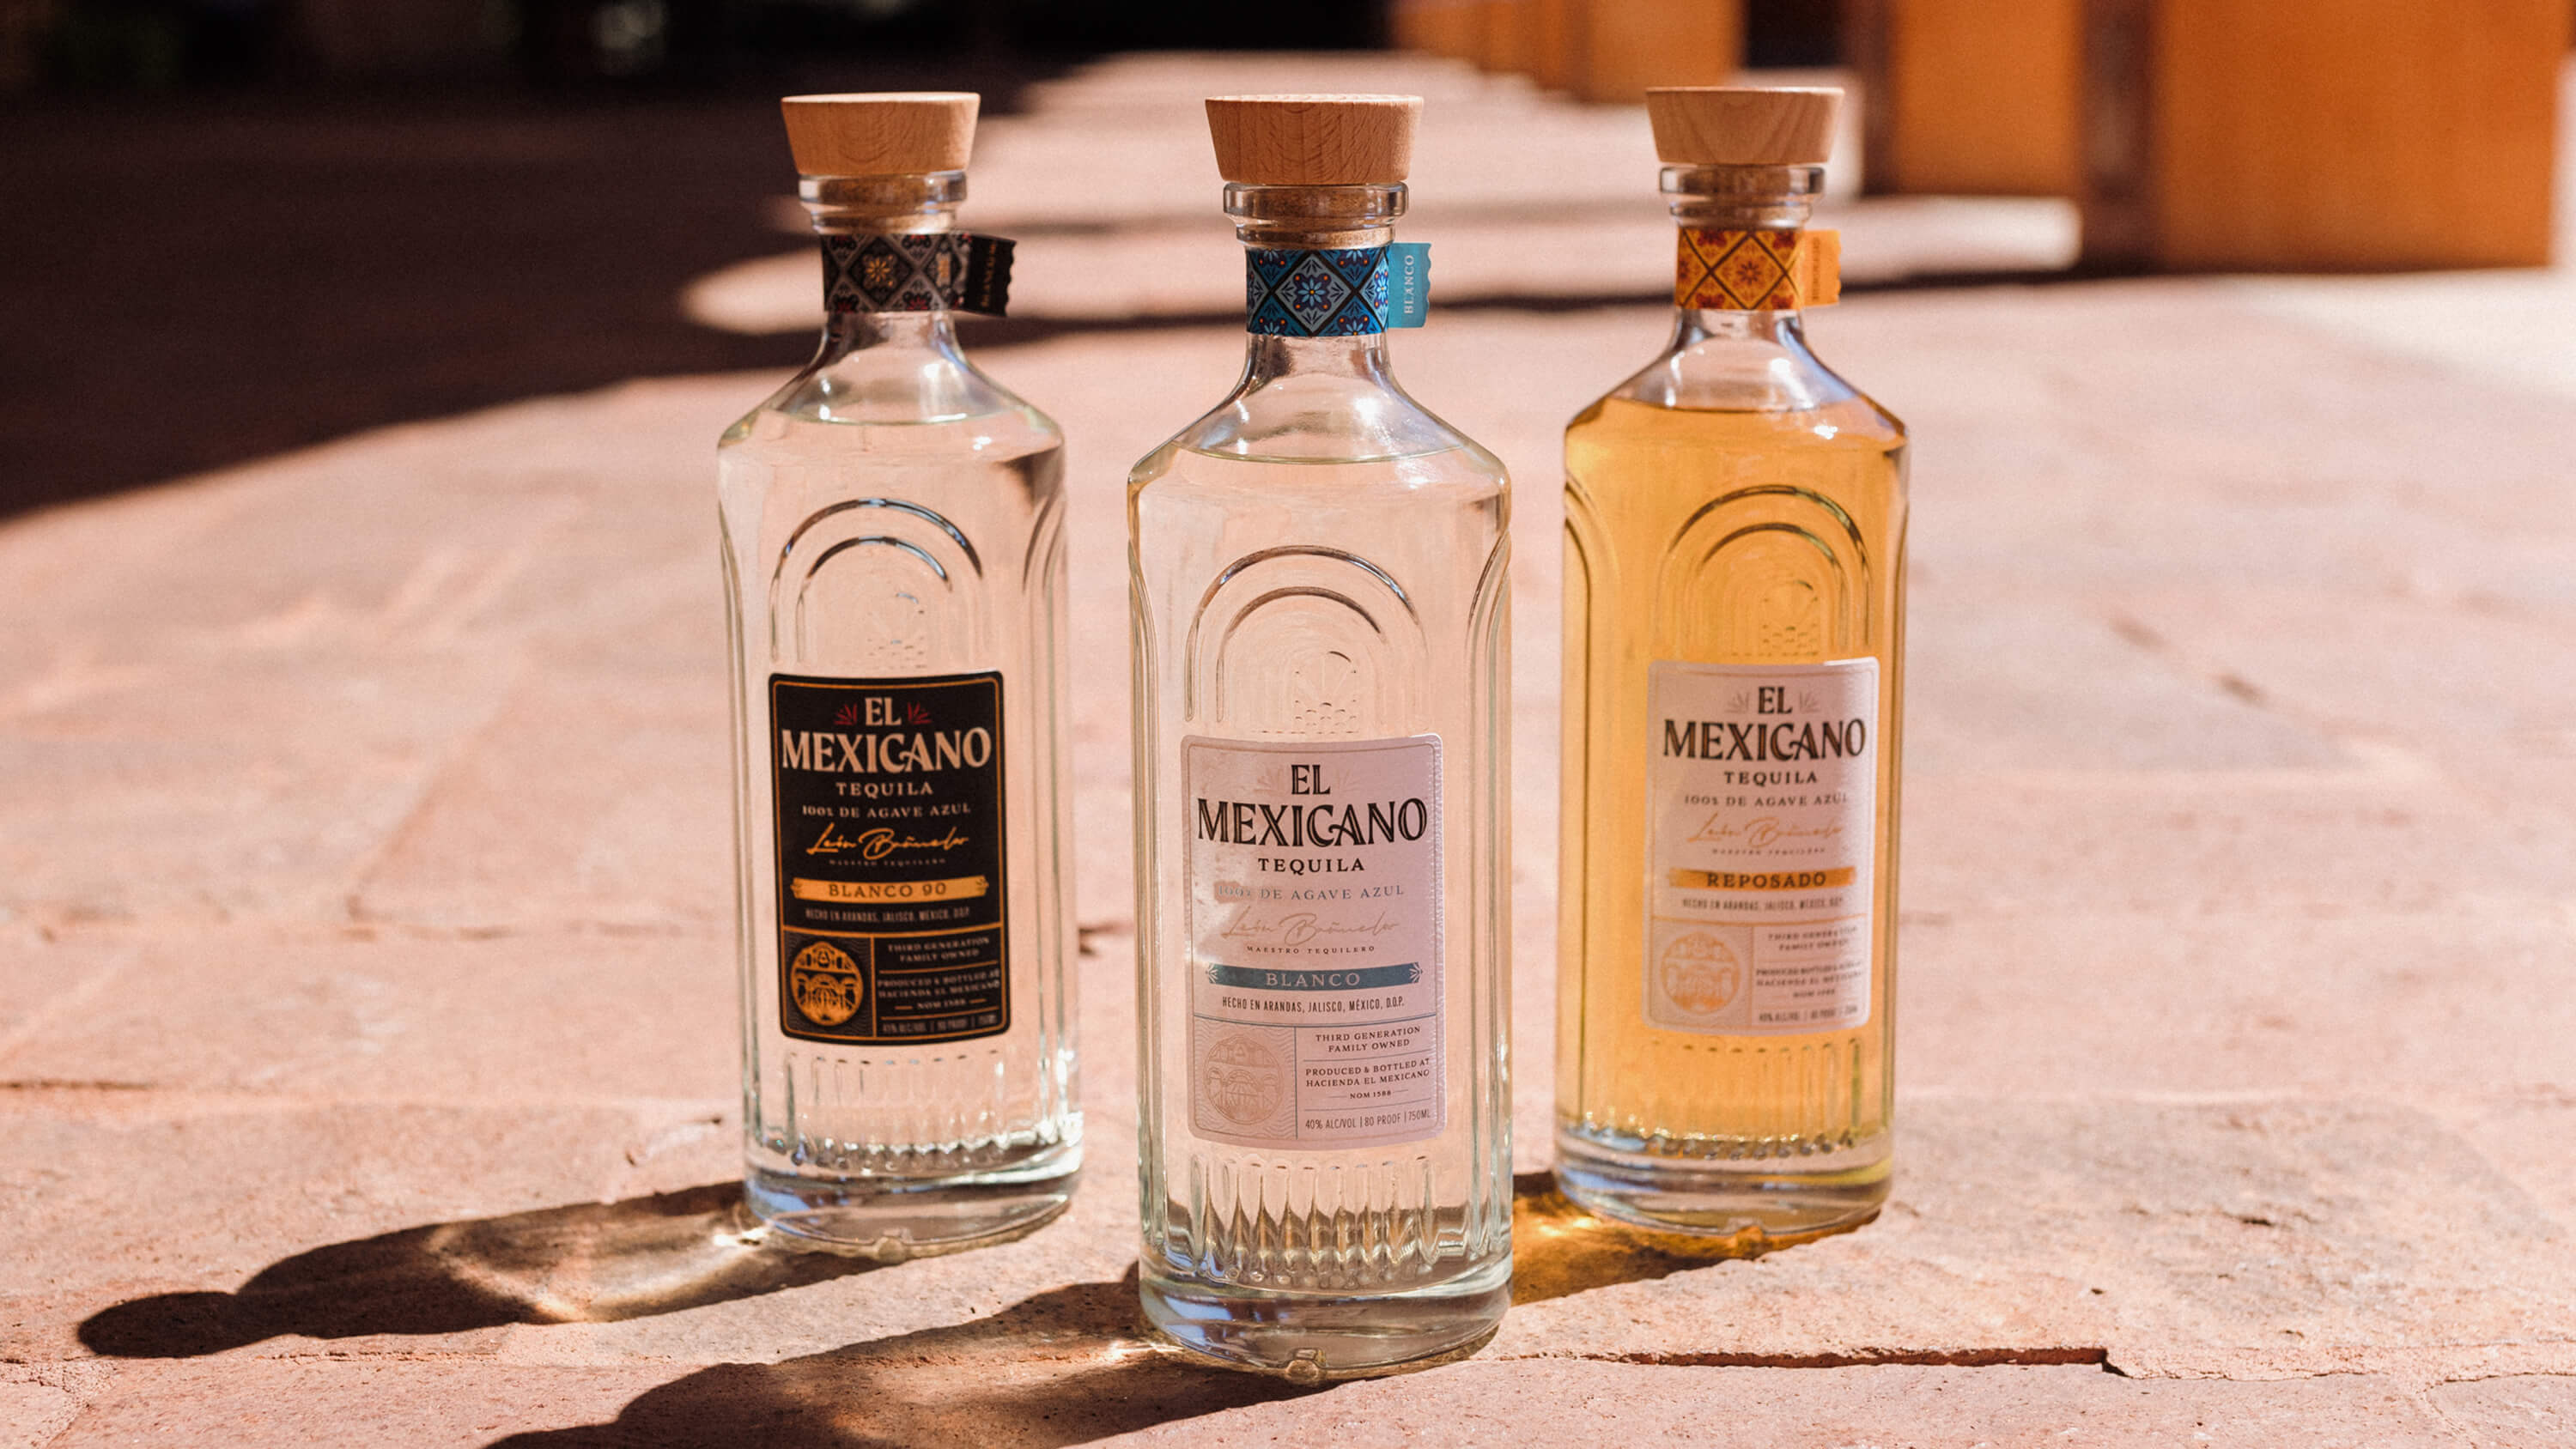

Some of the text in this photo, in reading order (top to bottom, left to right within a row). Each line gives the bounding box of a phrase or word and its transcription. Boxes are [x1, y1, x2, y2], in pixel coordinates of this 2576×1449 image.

[1404, 255, 1415, 314] BLANCO
[1758, 687, 1793, 714] EL
[865, 697, 902, 726] EL
[1663, 718, 1866, 761] MEXICANO
[781, 727, 992, 773] MEXICANO
[1291, 764, 1331, 795] EL
[1723, 771, 1818, 787] TEQUILA
[835, 782, 933, 798] TEQUILA
[1726, 796, 1746, 807] DE
[1754, 796, 1807, 807] AGAVE
[839, 806, 860, 818] DE
[867, 806, 923, 818] AGAVE
[930, 803, 971, 815] AZUL
[1197, 797, 1427, 847] MEXICANO
[1258, 858, 1364, 876] TEQUILA
[1707, 872, 1827, 888] REPOSADO
[829, 882, 947, 898] BLANCO 90
[1261, 888, 1283, 900] DE
[1291, 888, 1352, 900] AGAVE
[1360, 885, 1404, 898] AZUL
[888, 937, 990, 953] THIRD GENERATION
[1307, 946, 1375, 955] TEQUILERO
[900, 952, 938, 962] FAMILY
[1266, 972, 1360, 987] BLANCO
[1222, 996, 1247, 1009] HECHO
[1250, 998, 1261, 1010] EN
[1263, 999, 1305, 1014] ARANDAS,
[1308, 999, 1346, 1014] JALISCO,
[1349, 996, 1382, 1012] MÉXICO,
[1315, 1026, 1421, 1042] THIRD GENERATION
[1328, 1039, 1410, 1052] FAMILY OWNED
[1305, 1058, 1431, 1076] PRODUCED & BOTTLED AT
[1306, 1070, 1430, 1088] HACIENDA EL MEXICANO
[1350, 1091, 1370, 1100] NOM
[1305, 1119, 1323, 1131] 40%
[1325, 1117, 1356, 1130] ALC/VOL
[1364, 1116, 1375, 1127] 80
[1376, 1113, 1400, 1126] PROOF
